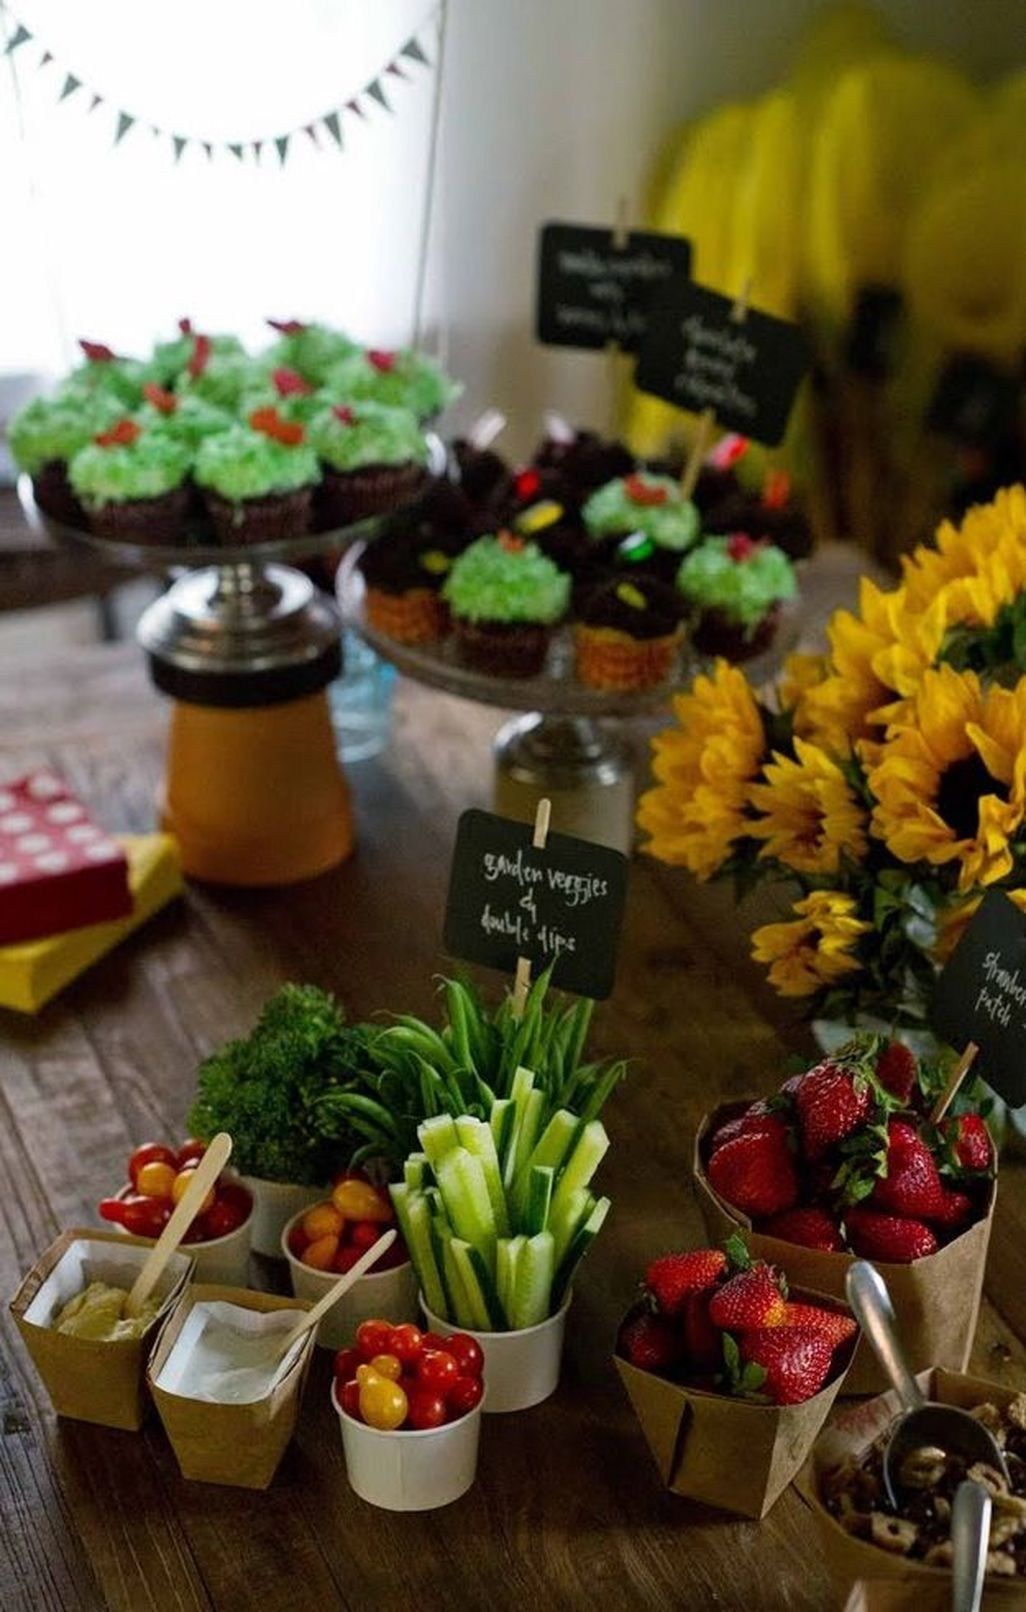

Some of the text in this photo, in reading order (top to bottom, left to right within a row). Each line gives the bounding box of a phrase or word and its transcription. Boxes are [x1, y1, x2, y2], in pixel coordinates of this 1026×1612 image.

[484, 849, 608, 907] garden veggies
[481, 904, 576, 956] double dips
[519, 887, 537, 925] &
